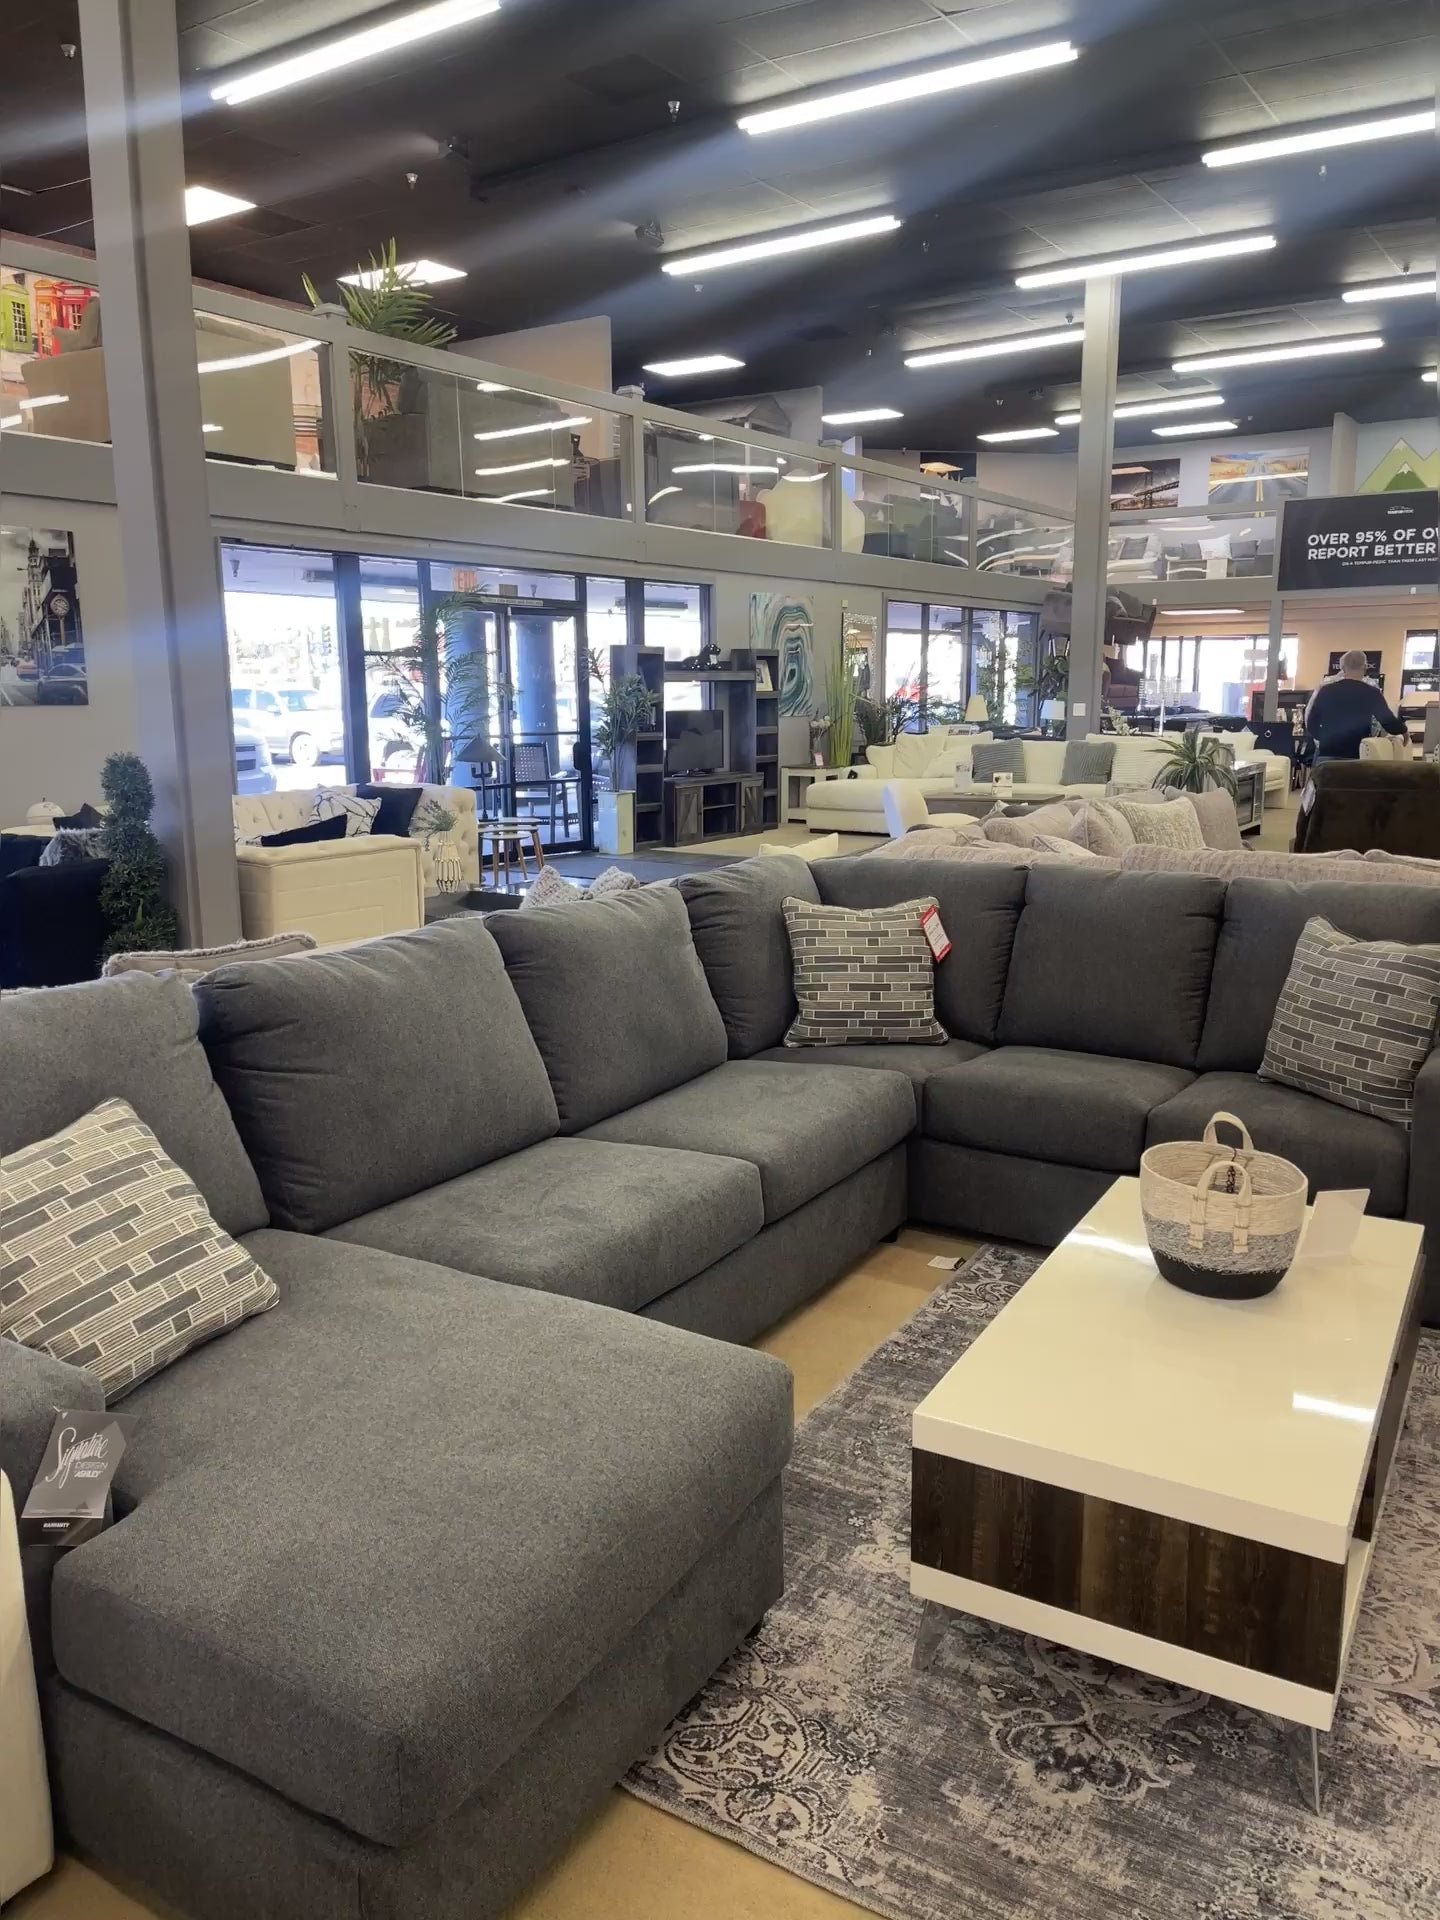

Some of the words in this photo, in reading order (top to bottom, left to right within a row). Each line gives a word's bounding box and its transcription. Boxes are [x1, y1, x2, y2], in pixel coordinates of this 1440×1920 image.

[1307, 533, 1349, 545] OVER
[1355, 530, 1387, 543] 95%
[1393, 528, 1416, 541] OF
[1307, 545, 1369, 560] REPORT
[1374, 542, 1436, 556] BETTER
